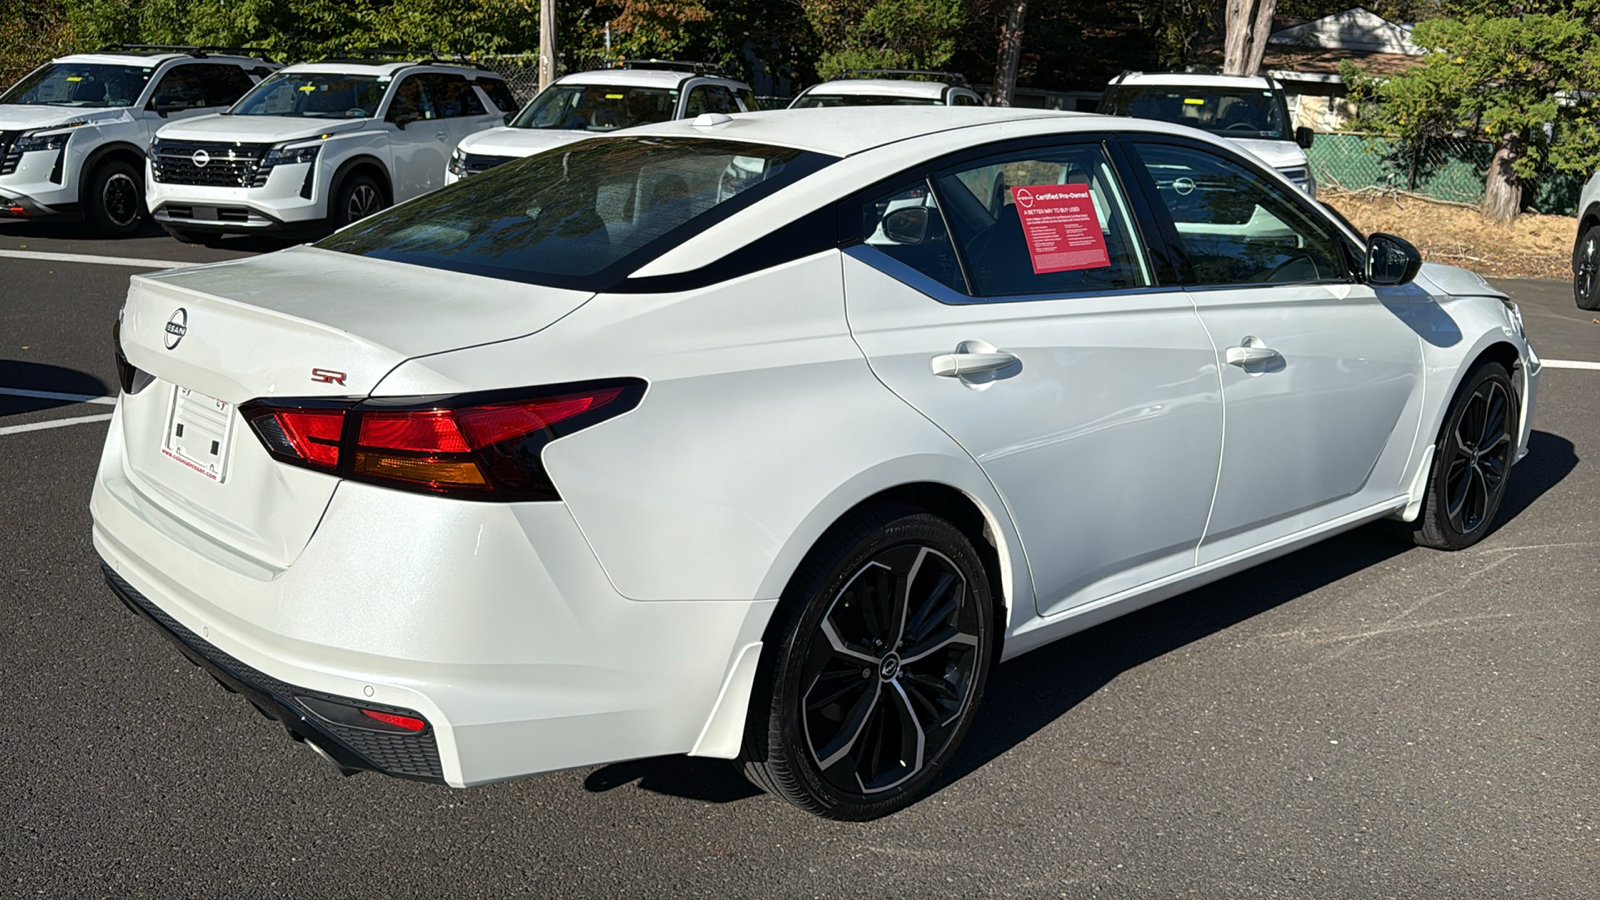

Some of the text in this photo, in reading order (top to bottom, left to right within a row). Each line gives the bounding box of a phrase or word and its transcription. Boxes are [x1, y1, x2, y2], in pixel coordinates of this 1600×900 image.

[1036, 192, 1059, 201] Certified
[311, 367, 347, 387] SR
[161, 448, 217, 481] www.colonialnissan.com
